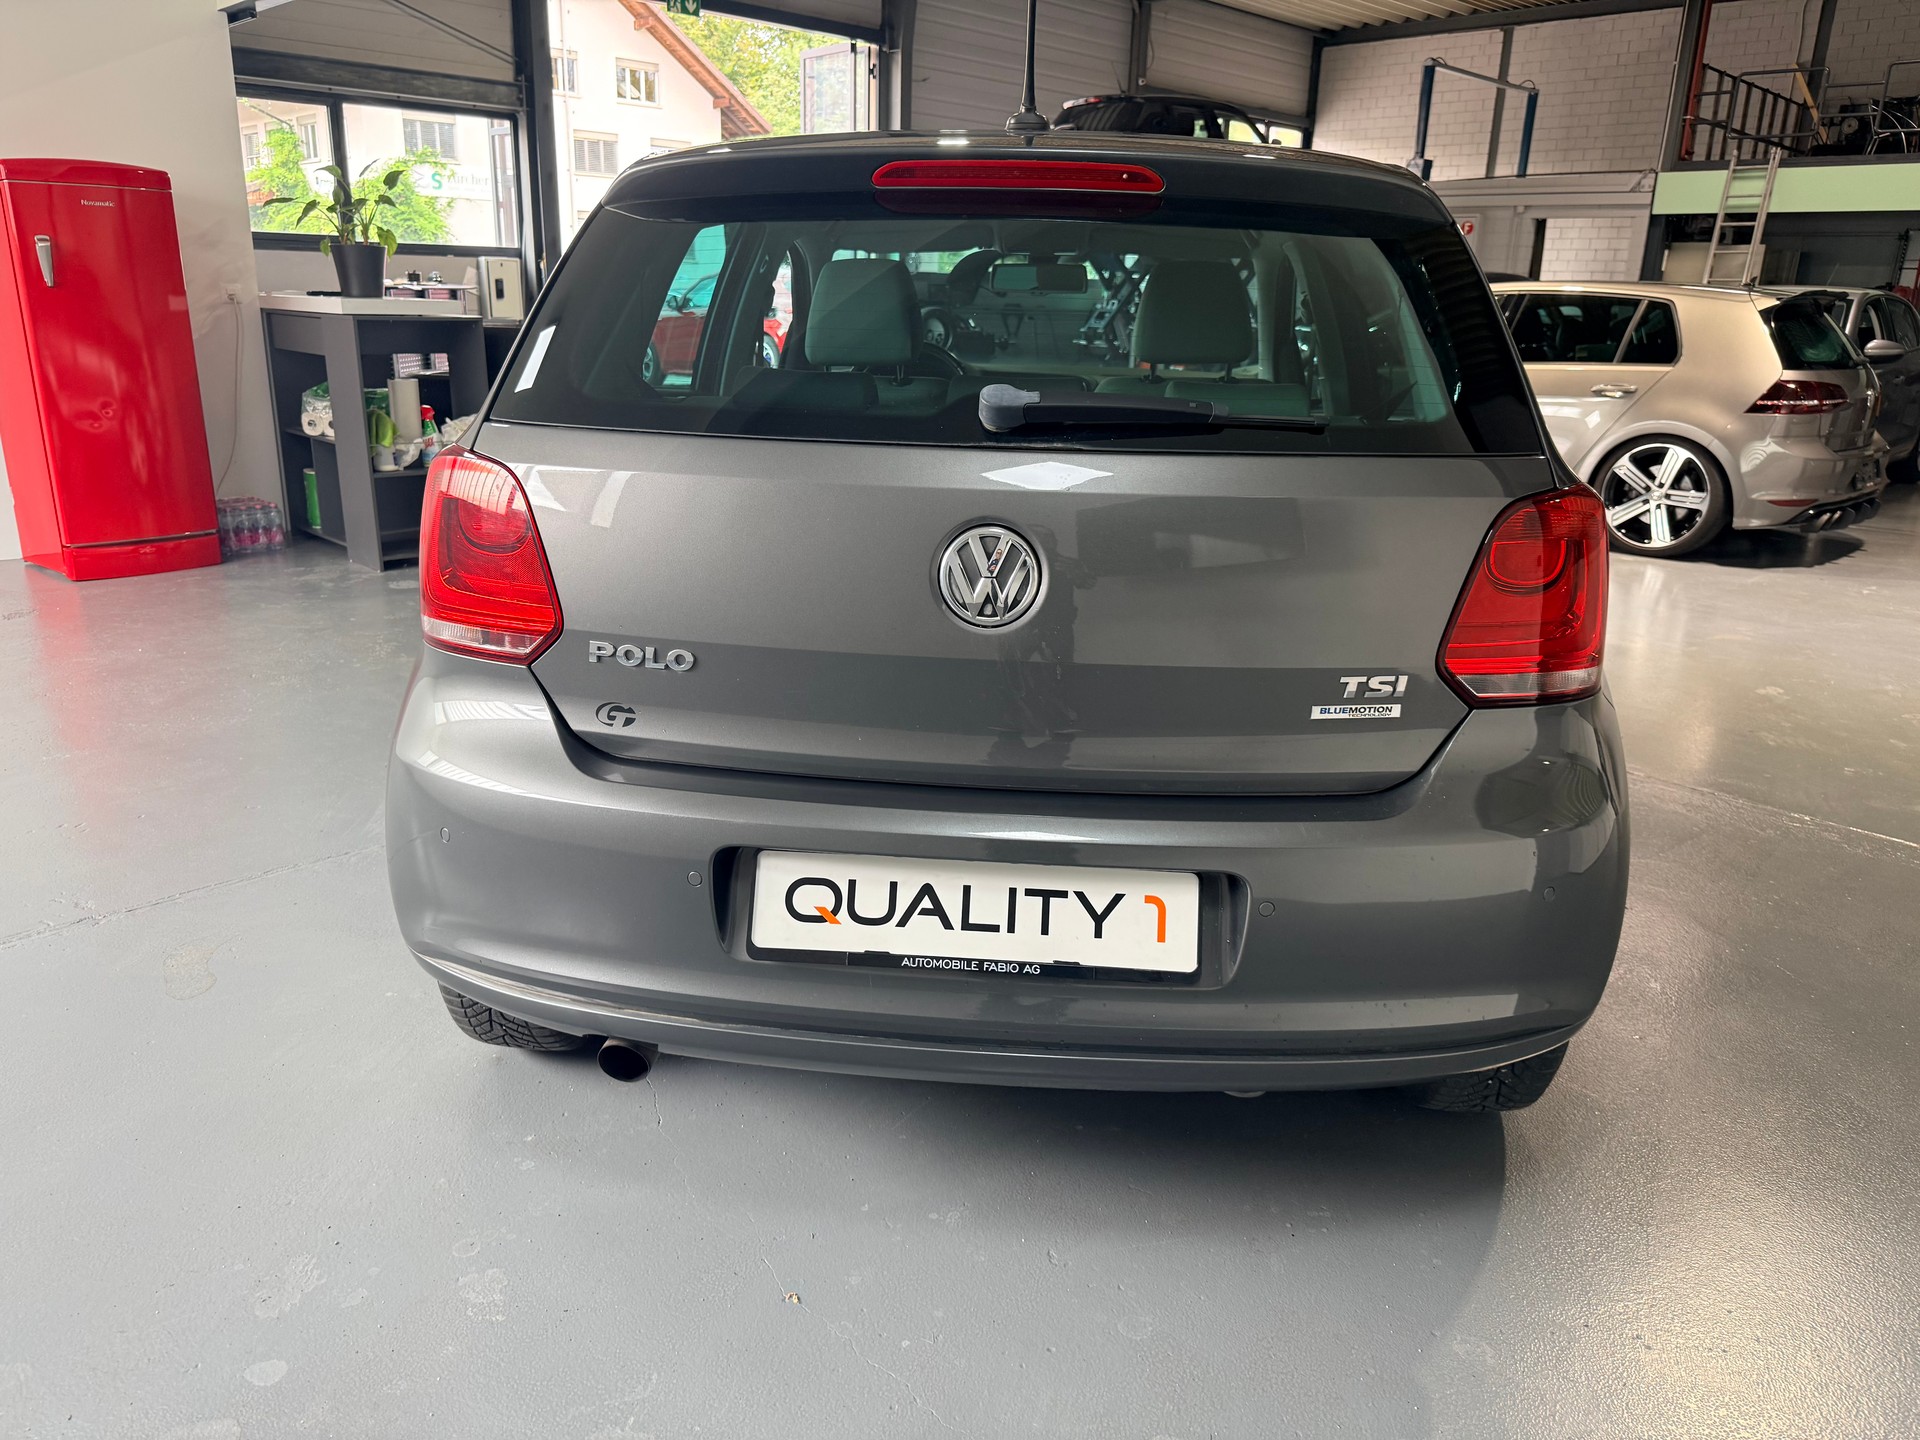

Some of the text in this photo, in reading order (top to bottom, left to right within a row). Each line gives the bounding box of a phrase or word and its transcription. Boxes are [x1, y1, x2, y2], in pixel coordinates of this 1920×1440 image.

[588, 640, 695, 671] POLO
[1340, 675, 1408, 698] TSI
[1319, 705, 1393, 715] BLUEMOTION
[784, 876, 1167, 943] QUALITY 1
[901, 957, 1041, 975] AUTOMOBILE FABIO AG
